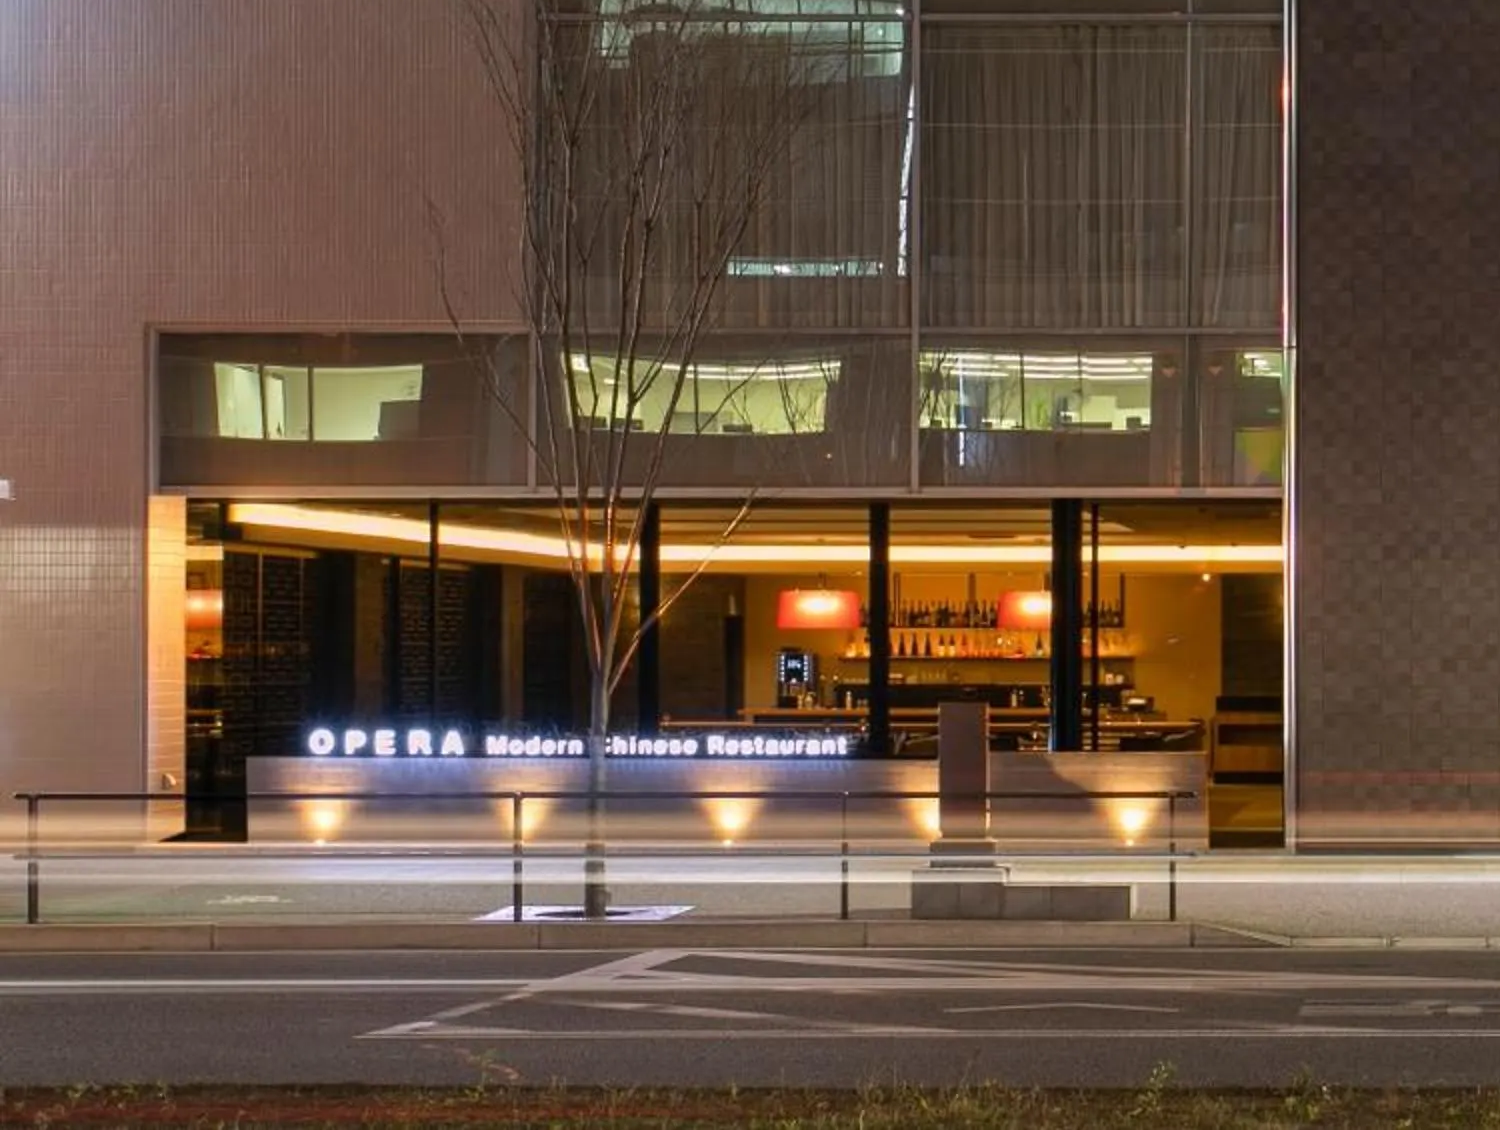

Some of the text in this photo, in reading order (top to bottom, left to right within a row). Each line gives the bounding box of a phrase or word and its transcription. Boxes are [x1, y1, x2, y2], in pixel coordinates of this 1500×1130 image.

[308, 728, 848, 756] OPERA Modern hinese Restaurant
